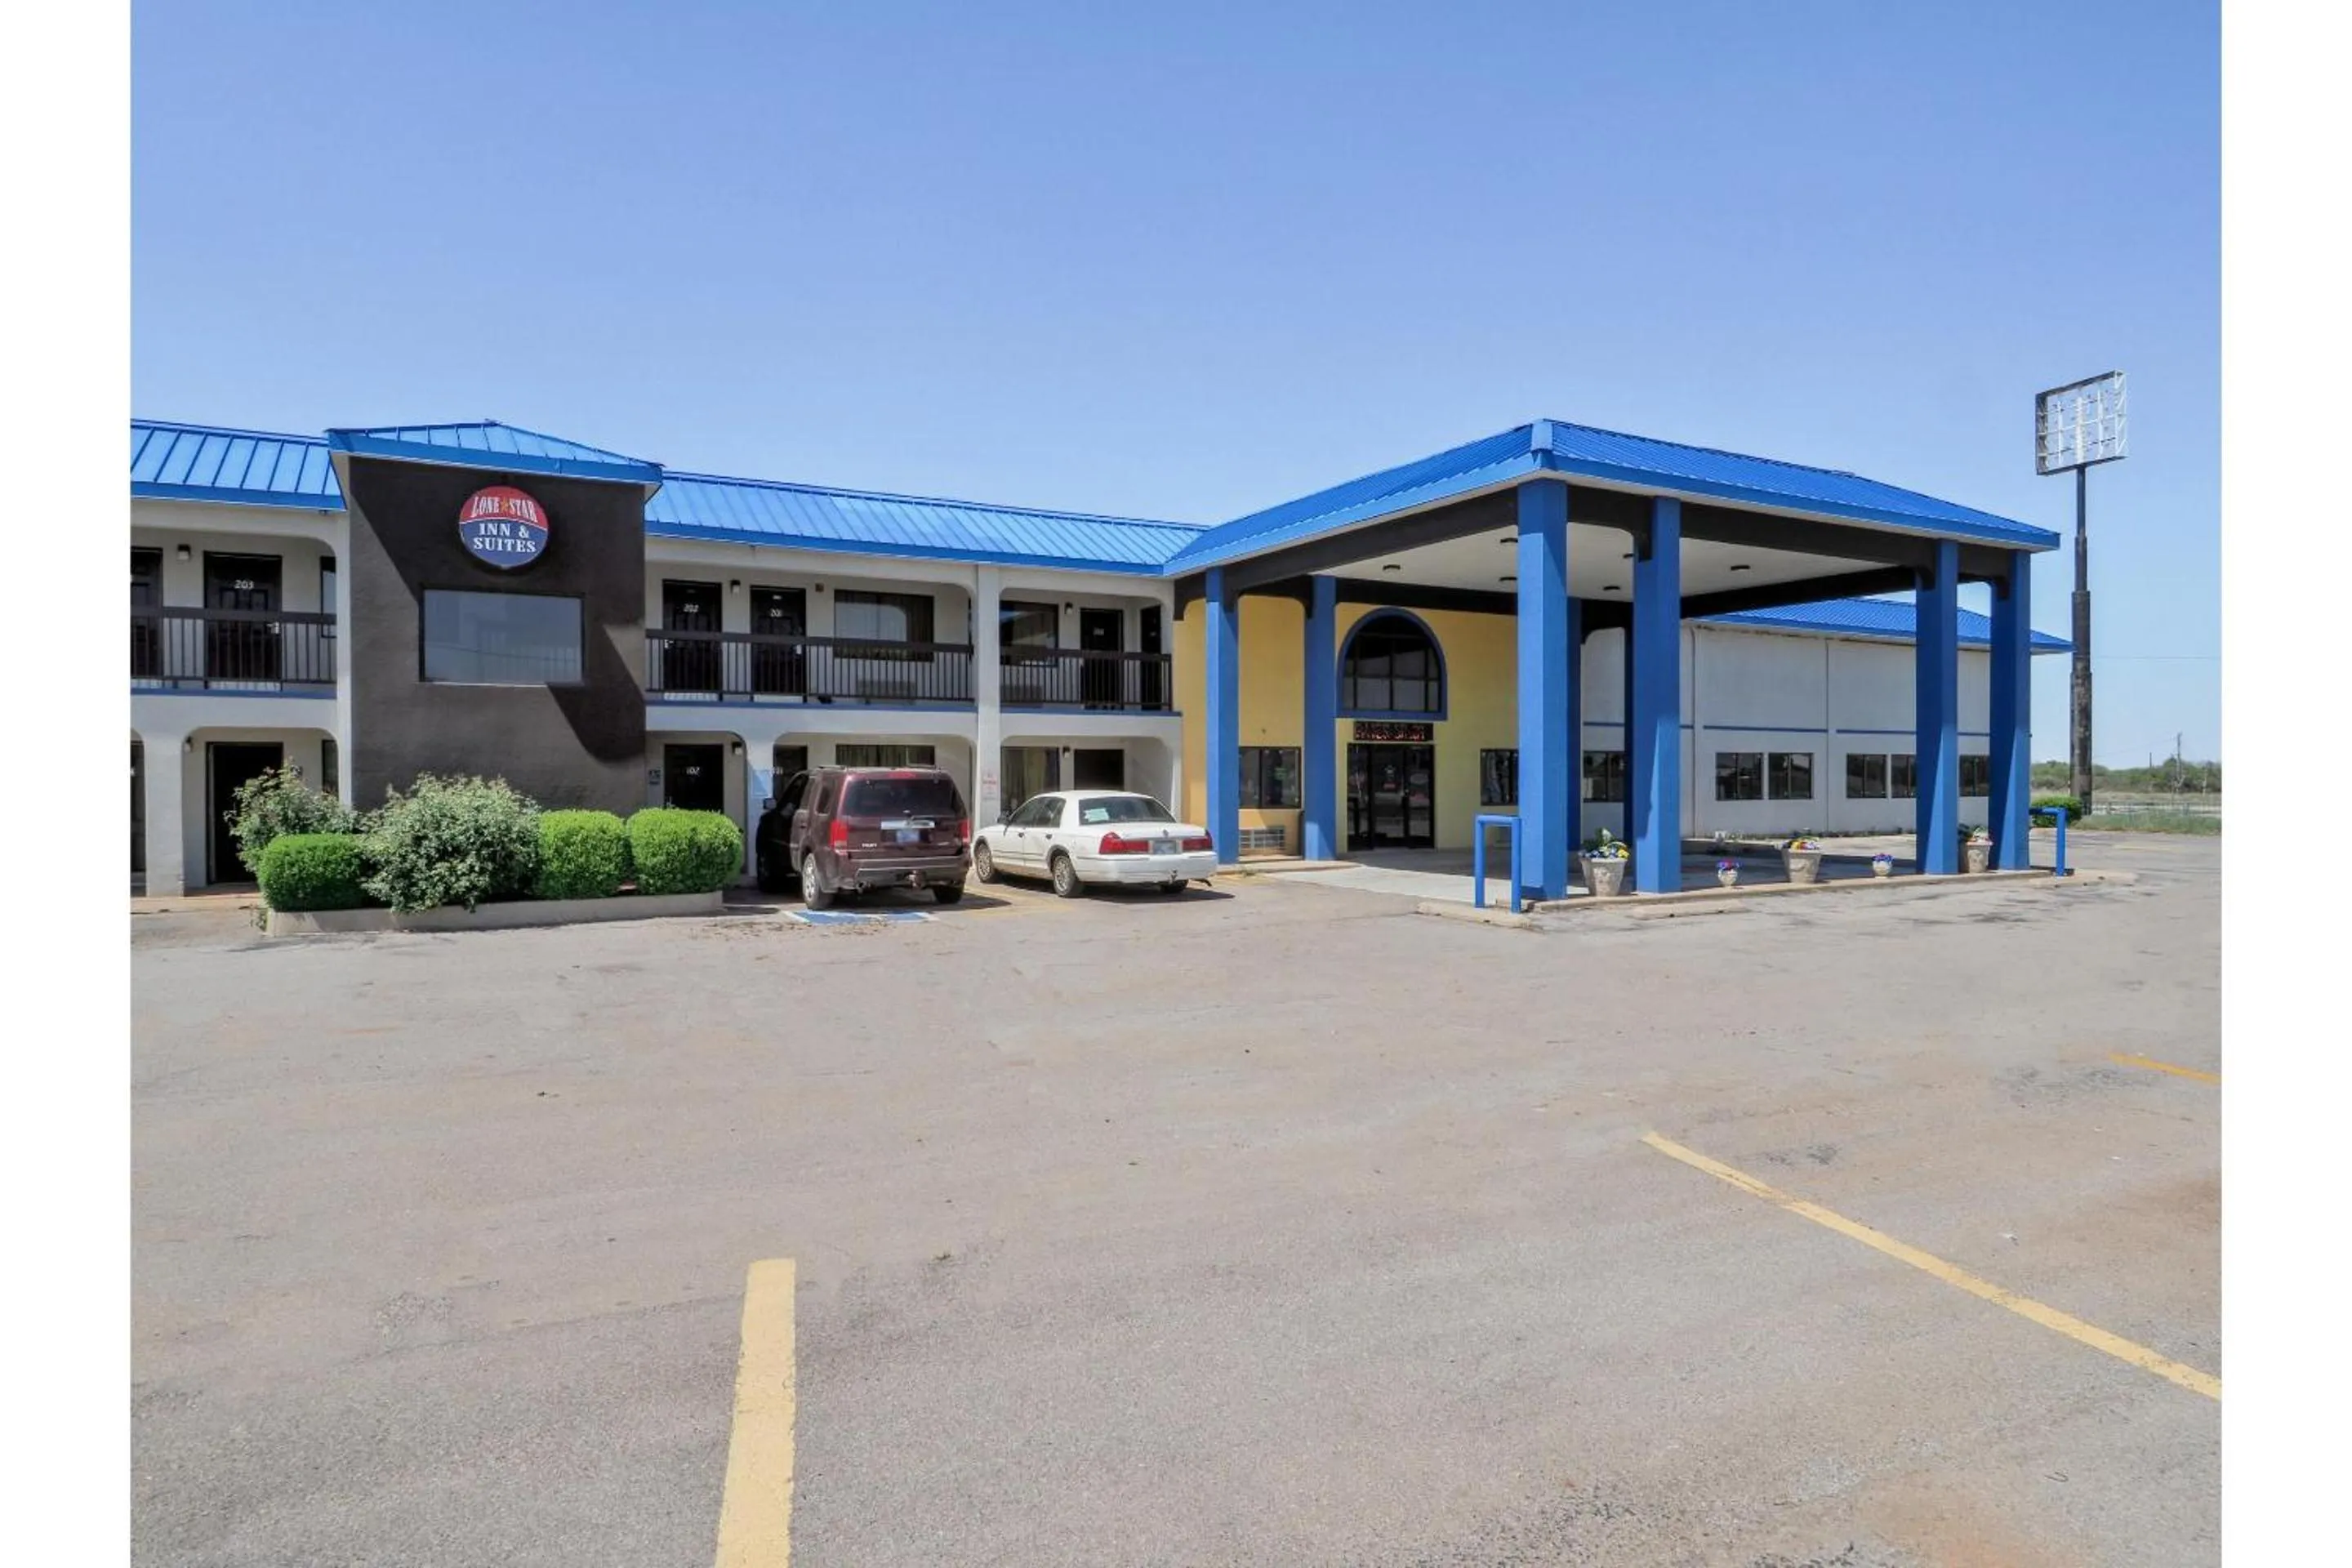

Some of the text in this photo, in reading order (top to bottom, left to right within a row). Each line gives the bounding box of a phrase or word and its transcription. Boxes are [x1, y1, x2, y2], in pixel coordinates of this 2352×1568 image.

[470, 497, 539, 523] LONE STAR
[479, 523, 530, 539] INN &
[474, 537, 537, 554] SUITES
[234, 579, 254, 590] 203
